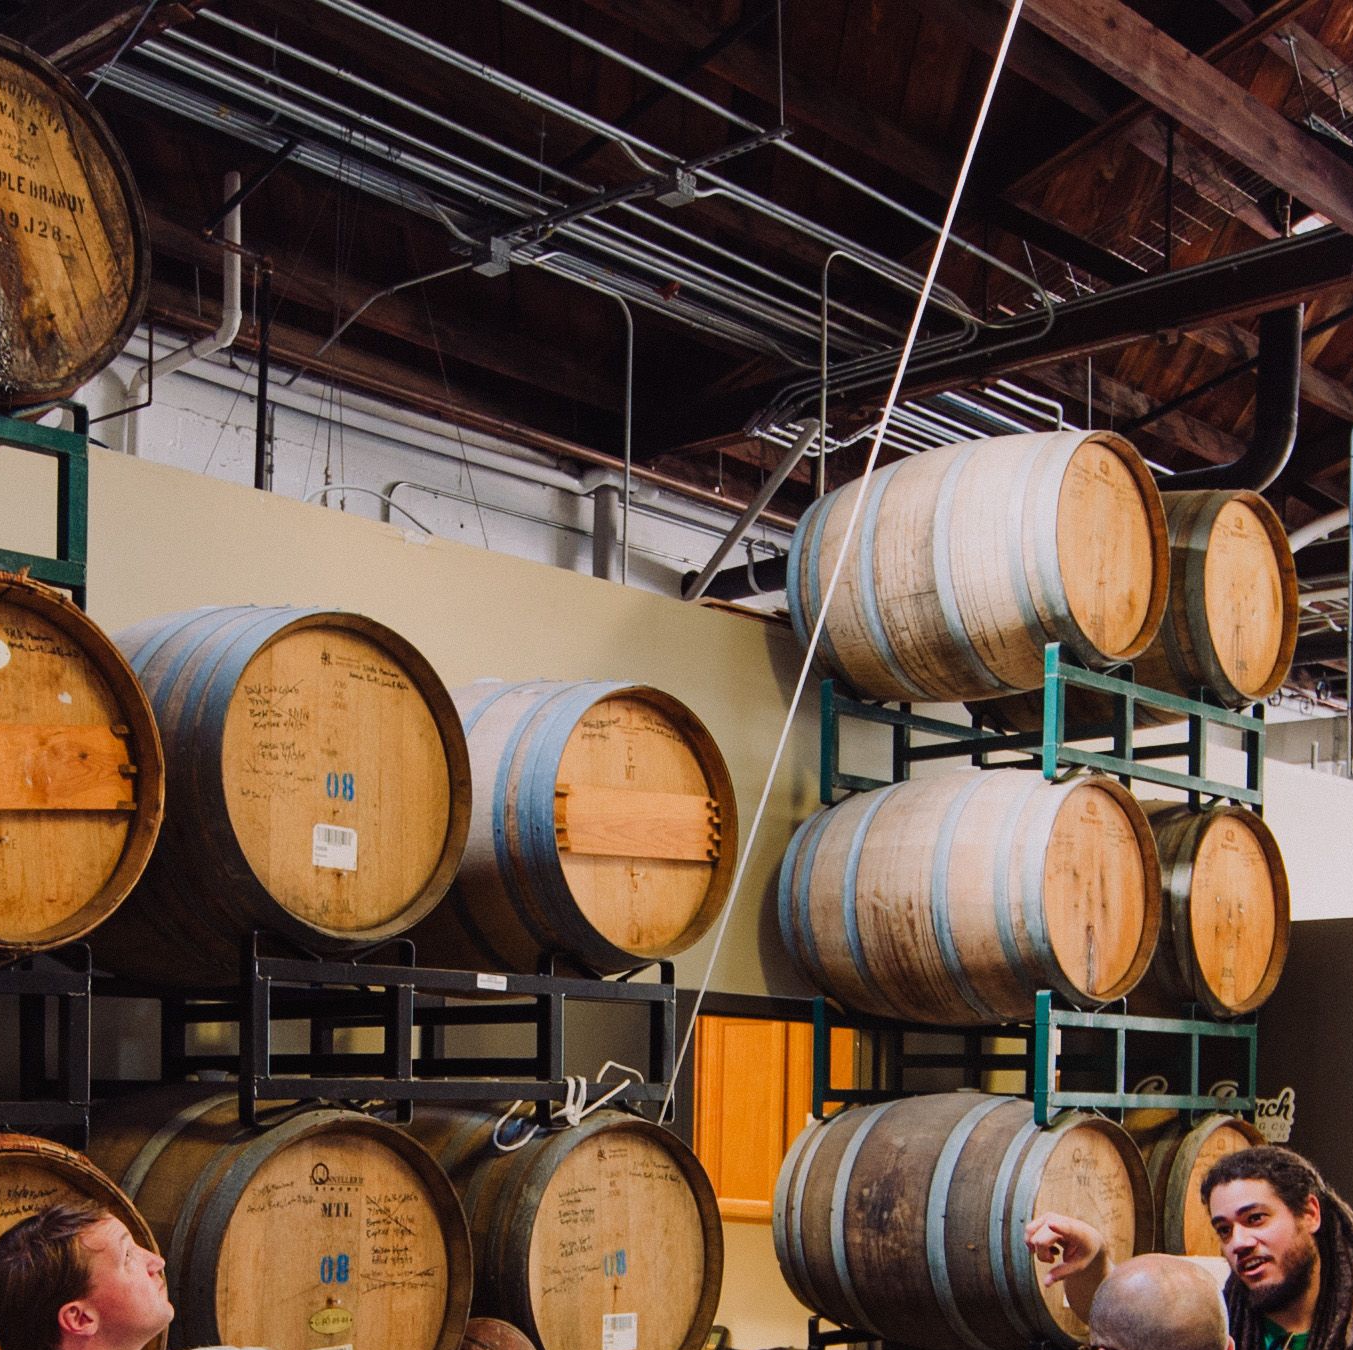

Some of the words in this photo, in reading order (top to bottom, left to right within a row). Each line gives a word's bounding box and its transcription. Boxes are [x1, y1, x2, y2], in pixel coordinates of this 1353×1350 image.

[30, 180, 86, 215] BRANDY
[326, 772, 355, 801] 08
[320, 1254, 350, 1285] 08
[604, 1249, 627, 1277] 08
